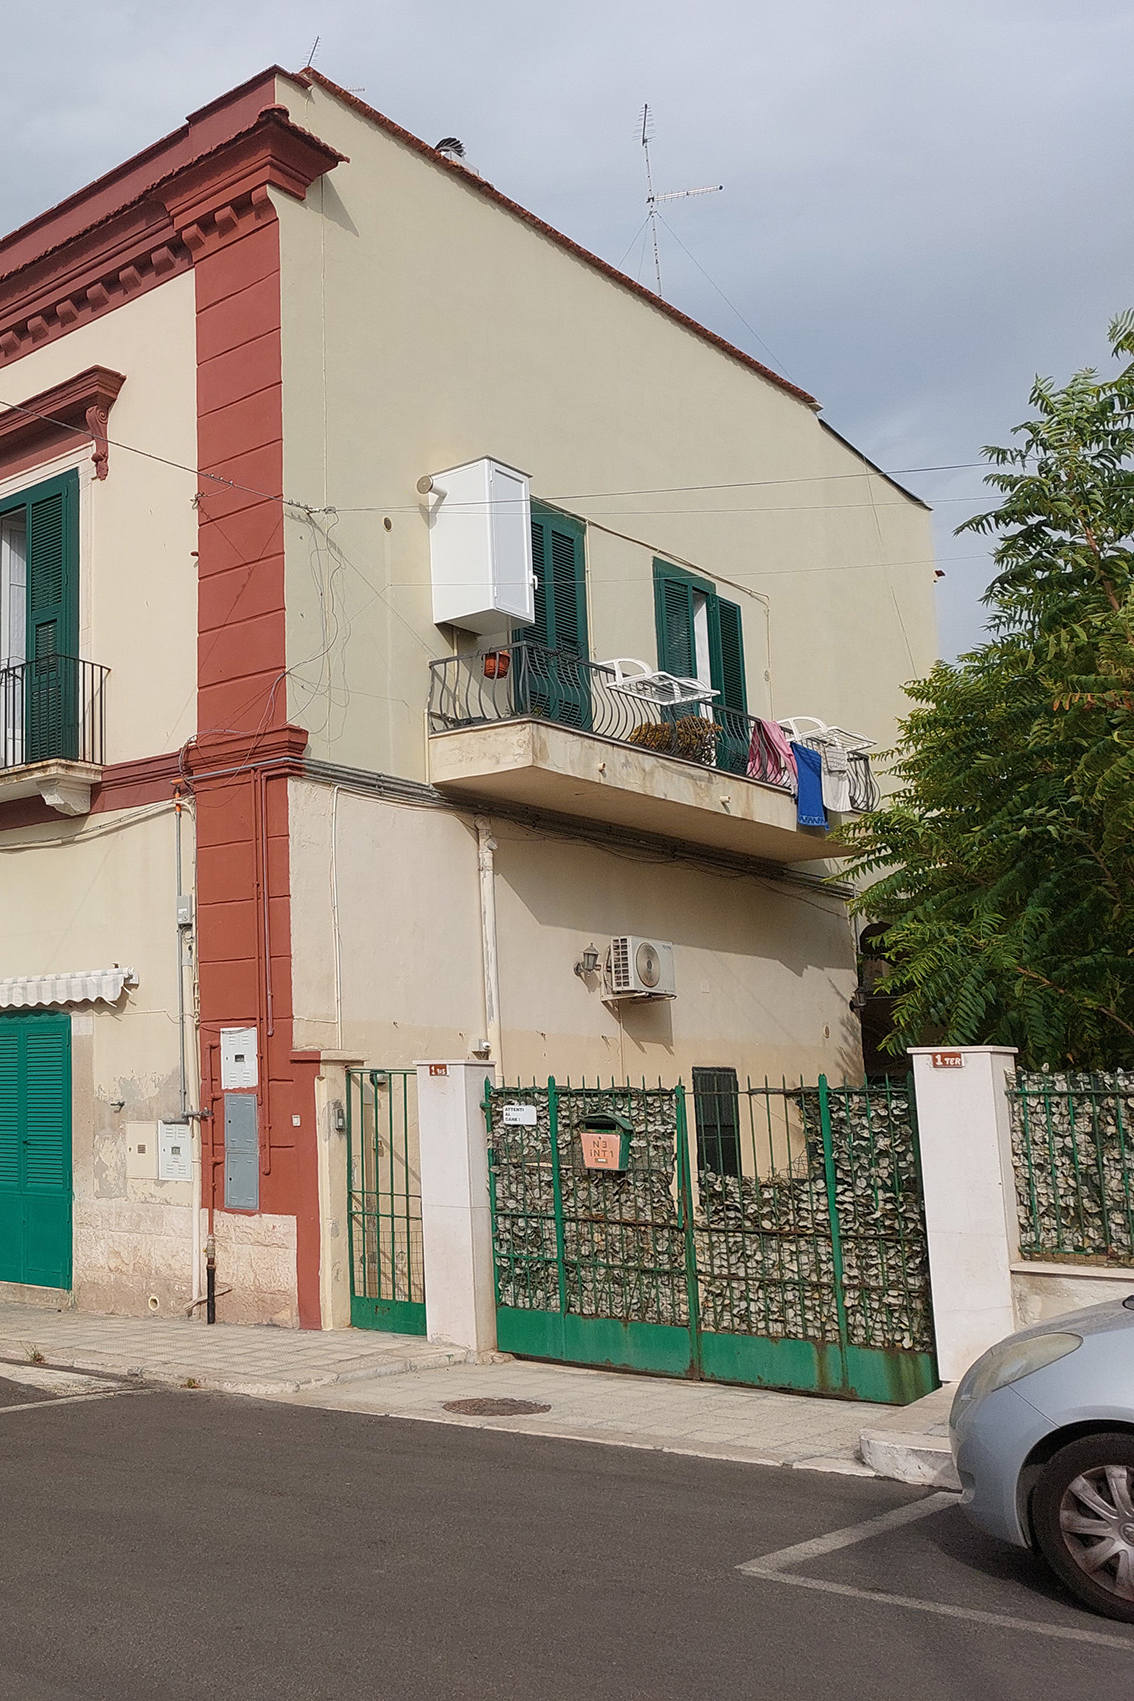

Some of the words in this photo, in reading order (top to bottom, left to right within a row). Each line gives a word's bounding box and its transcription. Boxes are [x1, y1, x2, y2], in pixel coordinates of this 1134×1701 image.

[935, 1054, 943, 1066] 1
[944, 1057, 961, 1066] TER
[431, 1065, 436, 1075] 1
